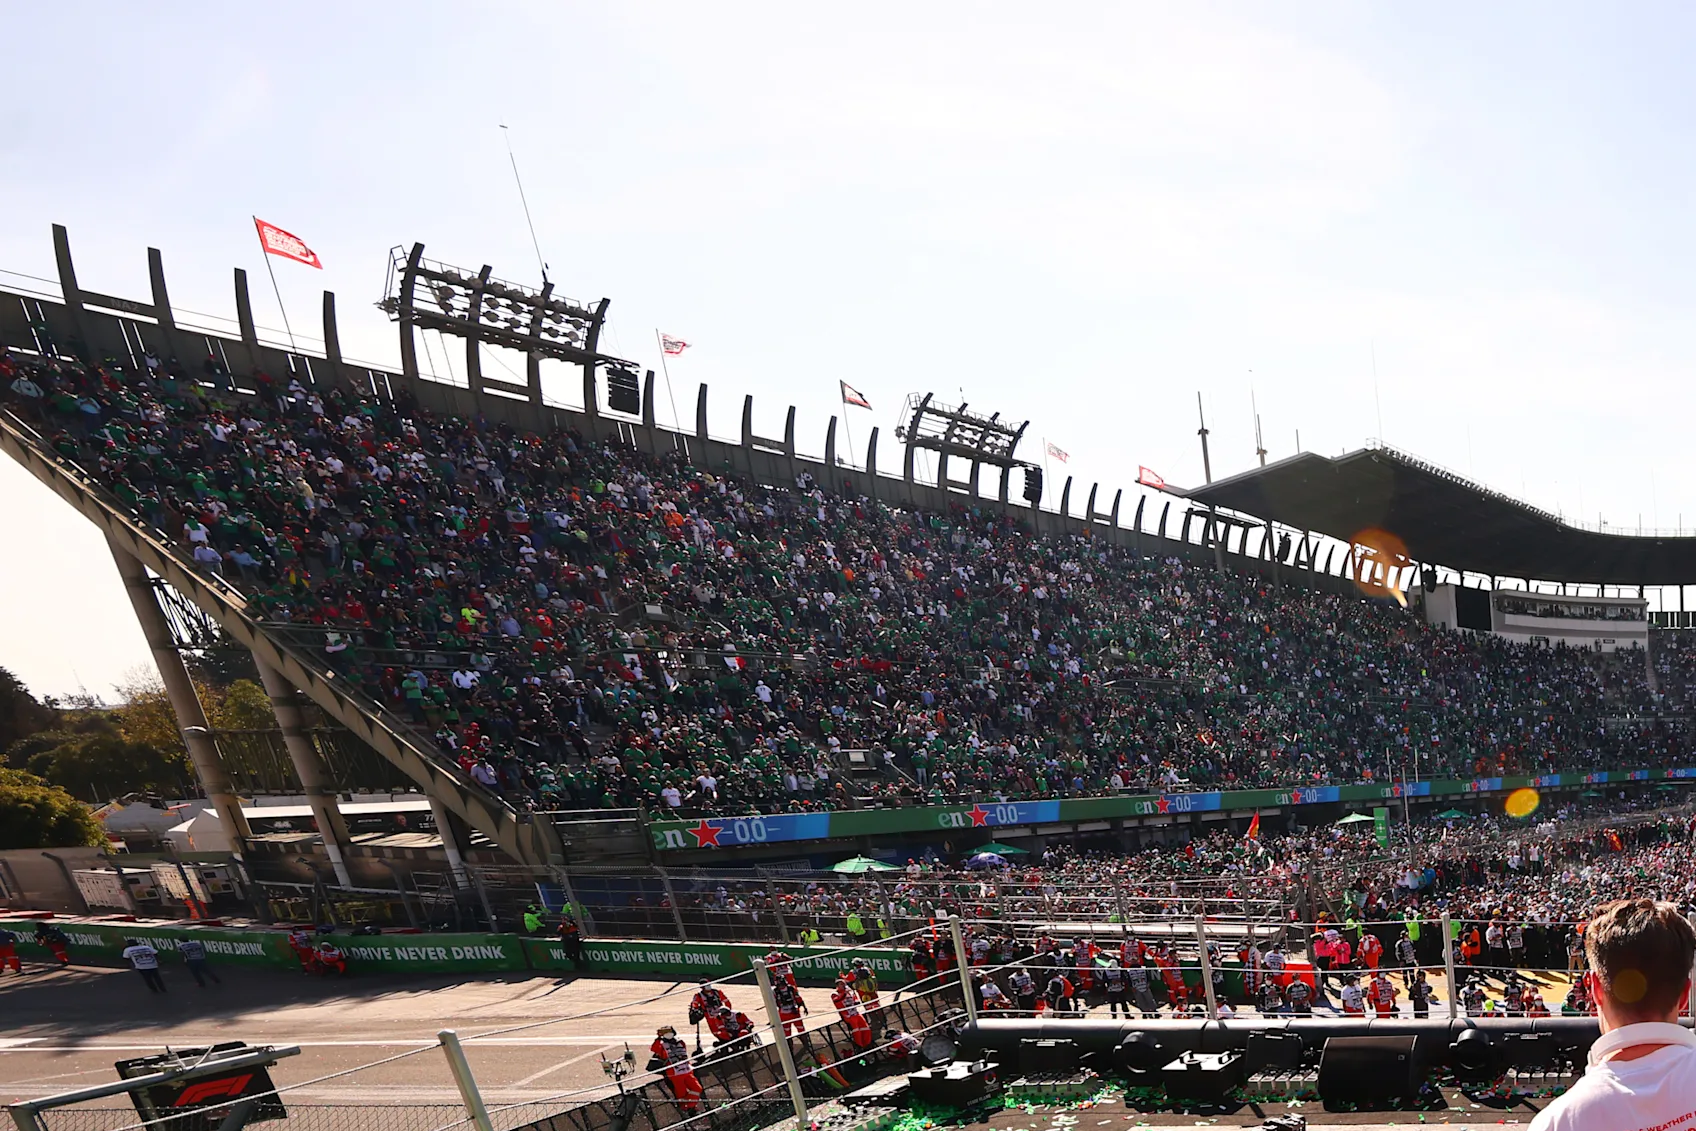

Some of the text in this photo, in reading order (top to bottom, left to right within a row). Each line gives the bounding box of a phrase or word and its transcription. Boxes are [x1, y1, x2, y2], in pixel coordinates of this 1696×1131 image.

[1135, 796, 1191, 814] en 0.0
[938, 805, 1018, 828] en 0.0
[652, 820, 767, 848] en 0.0
[77, 933, 104, 947] DRINK
[152, 937, 173, 951] YOU
[203, 940, 235, 954] NEVER
[235, 942, 266, 956] DRINK
[353, 946, 393, 960] DRIVE
[395, 946, 448, 960] NEVER
[451, 945, 506, 960] DRINK
[585, 950, 609, 962] YOU
[611, 950, 645, 963] DRIVE
[647, 951, 682, 965] NEVER
[685, 952, 722, 966] DRINK
[814, 957, 849, 970] DRIVE
